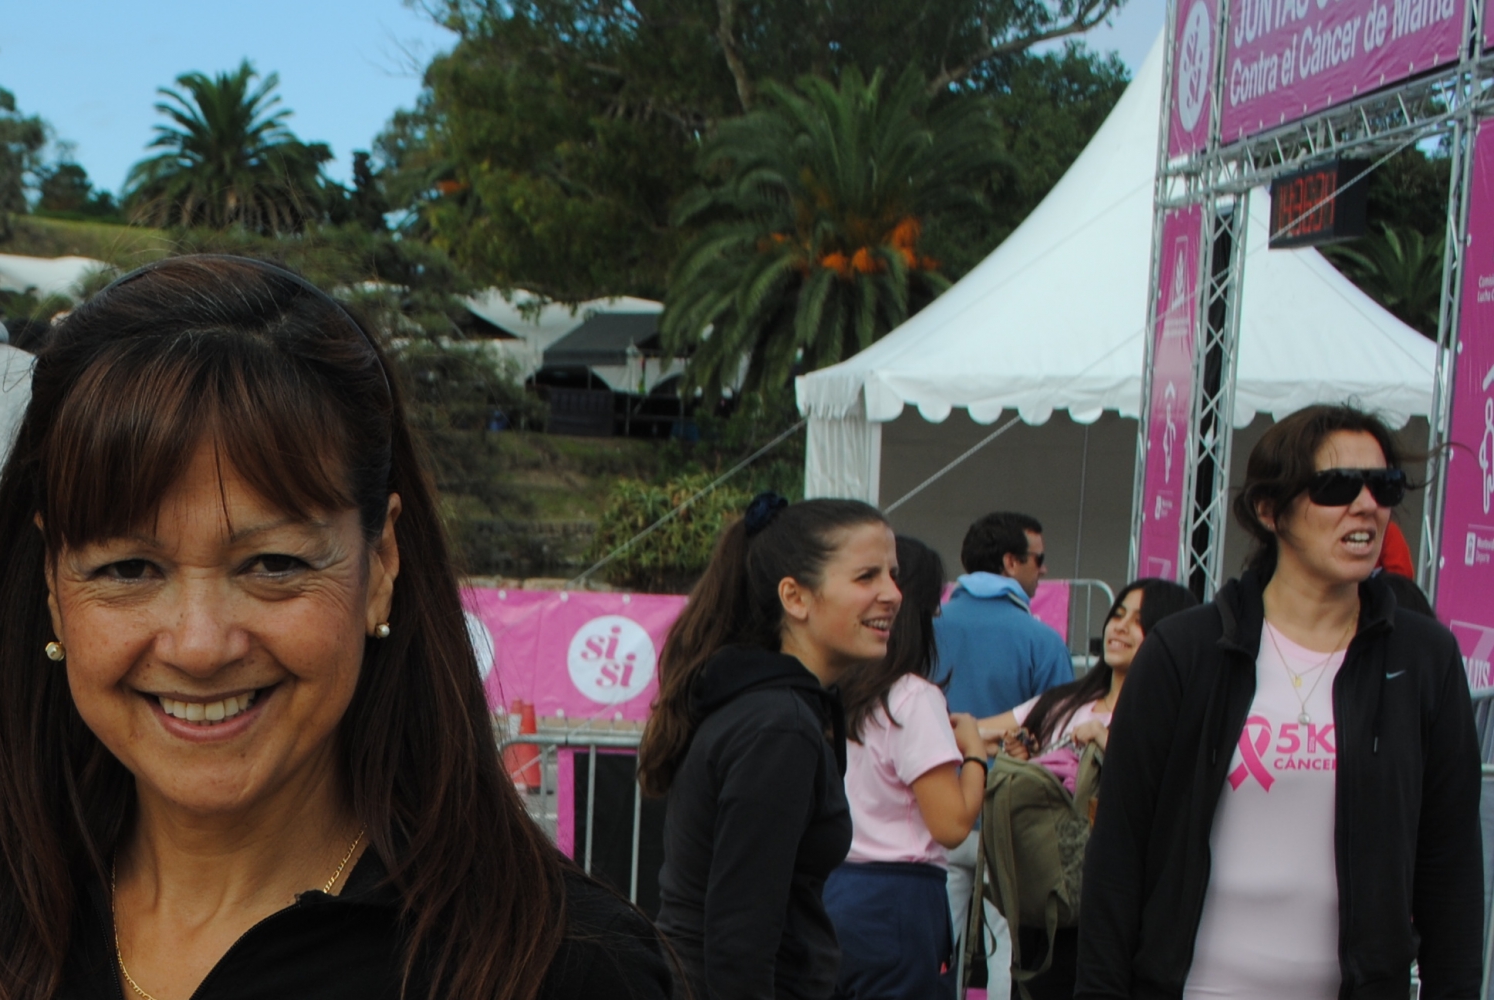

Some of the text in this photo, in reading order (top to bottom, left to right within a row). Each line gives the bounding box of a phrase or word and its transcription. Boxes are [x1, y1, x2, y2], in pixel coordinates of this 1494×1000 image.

[1230, 51, 1278, 107] Contra
[1281, 33, 1297, 87] el
[1299, 17, 1361, 79] Cáncer
[1363, 0, 1388, 53] de
[1276, 723, 1336, 754] 5K
